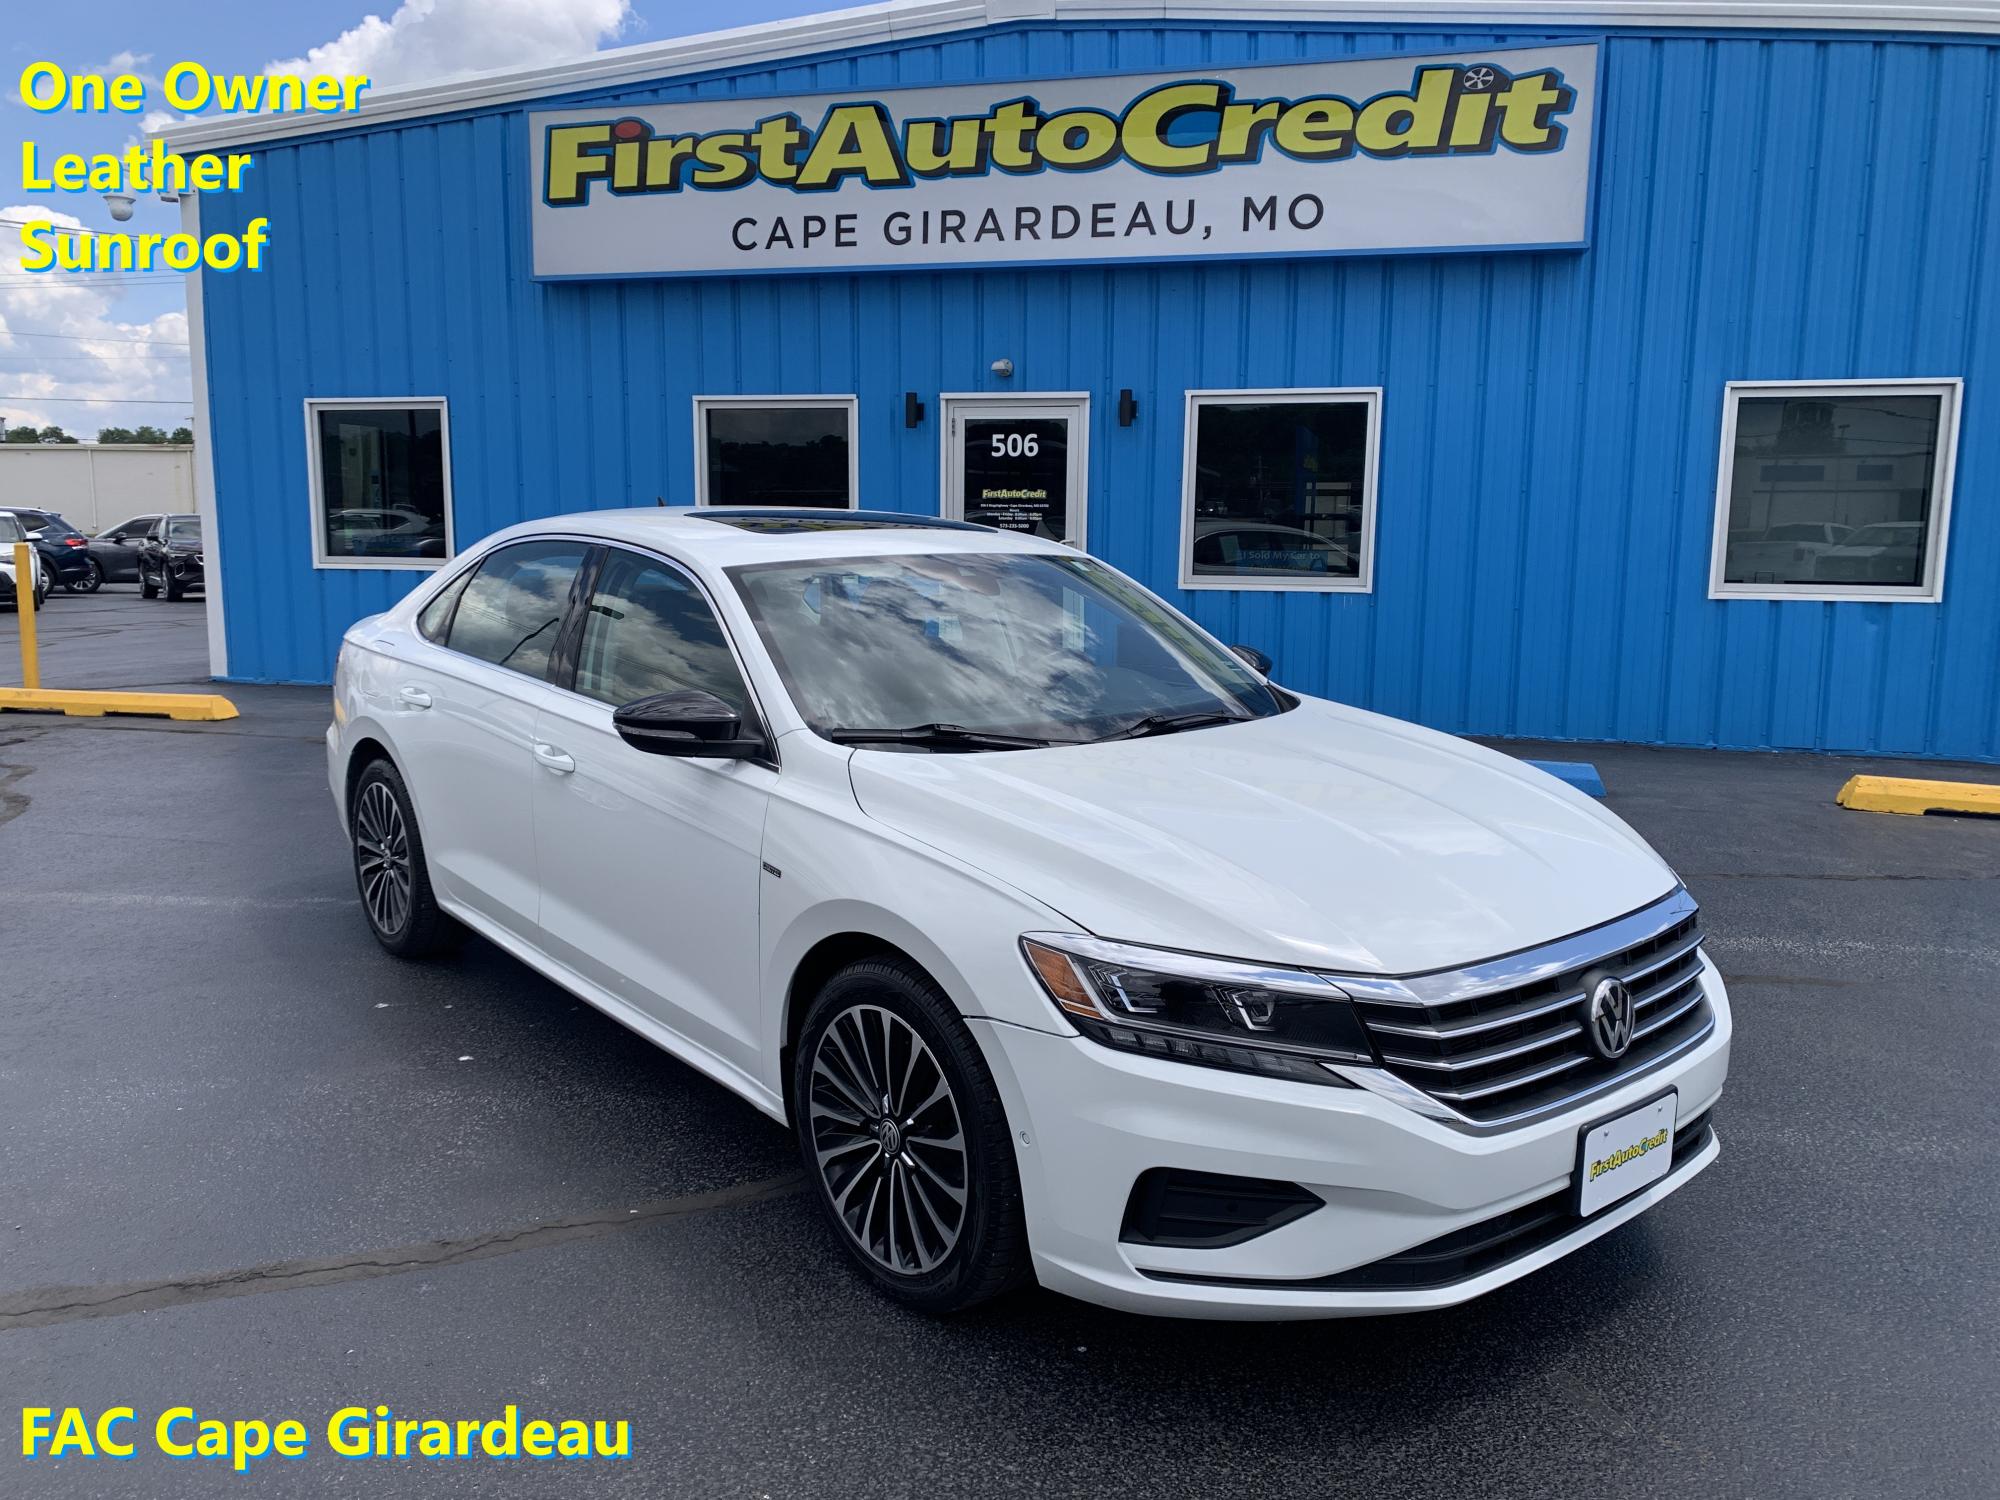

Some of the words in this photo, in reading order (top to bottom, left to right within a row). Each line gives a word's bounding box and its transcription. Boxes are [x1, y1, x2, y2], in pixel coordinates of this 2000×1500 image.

[546, 65, 1570, 204] FirstAutoCredit
[732, 214, 857, 251] CAPE
[884, 199, 1212, 246] GIRARDEAU,
[1242, 193, 1324, 232] MO
[991, 433, 1038, 456] 506
[982, 489, 1047, 499] FirstAutoCredit
[1249, 551, 1270, 560] Sold
[1273, 552, 1289, 562] My
[1310, 552, 1321, 560] to
[1589, 1128, 1668, 1181] FirstAutoCredit
